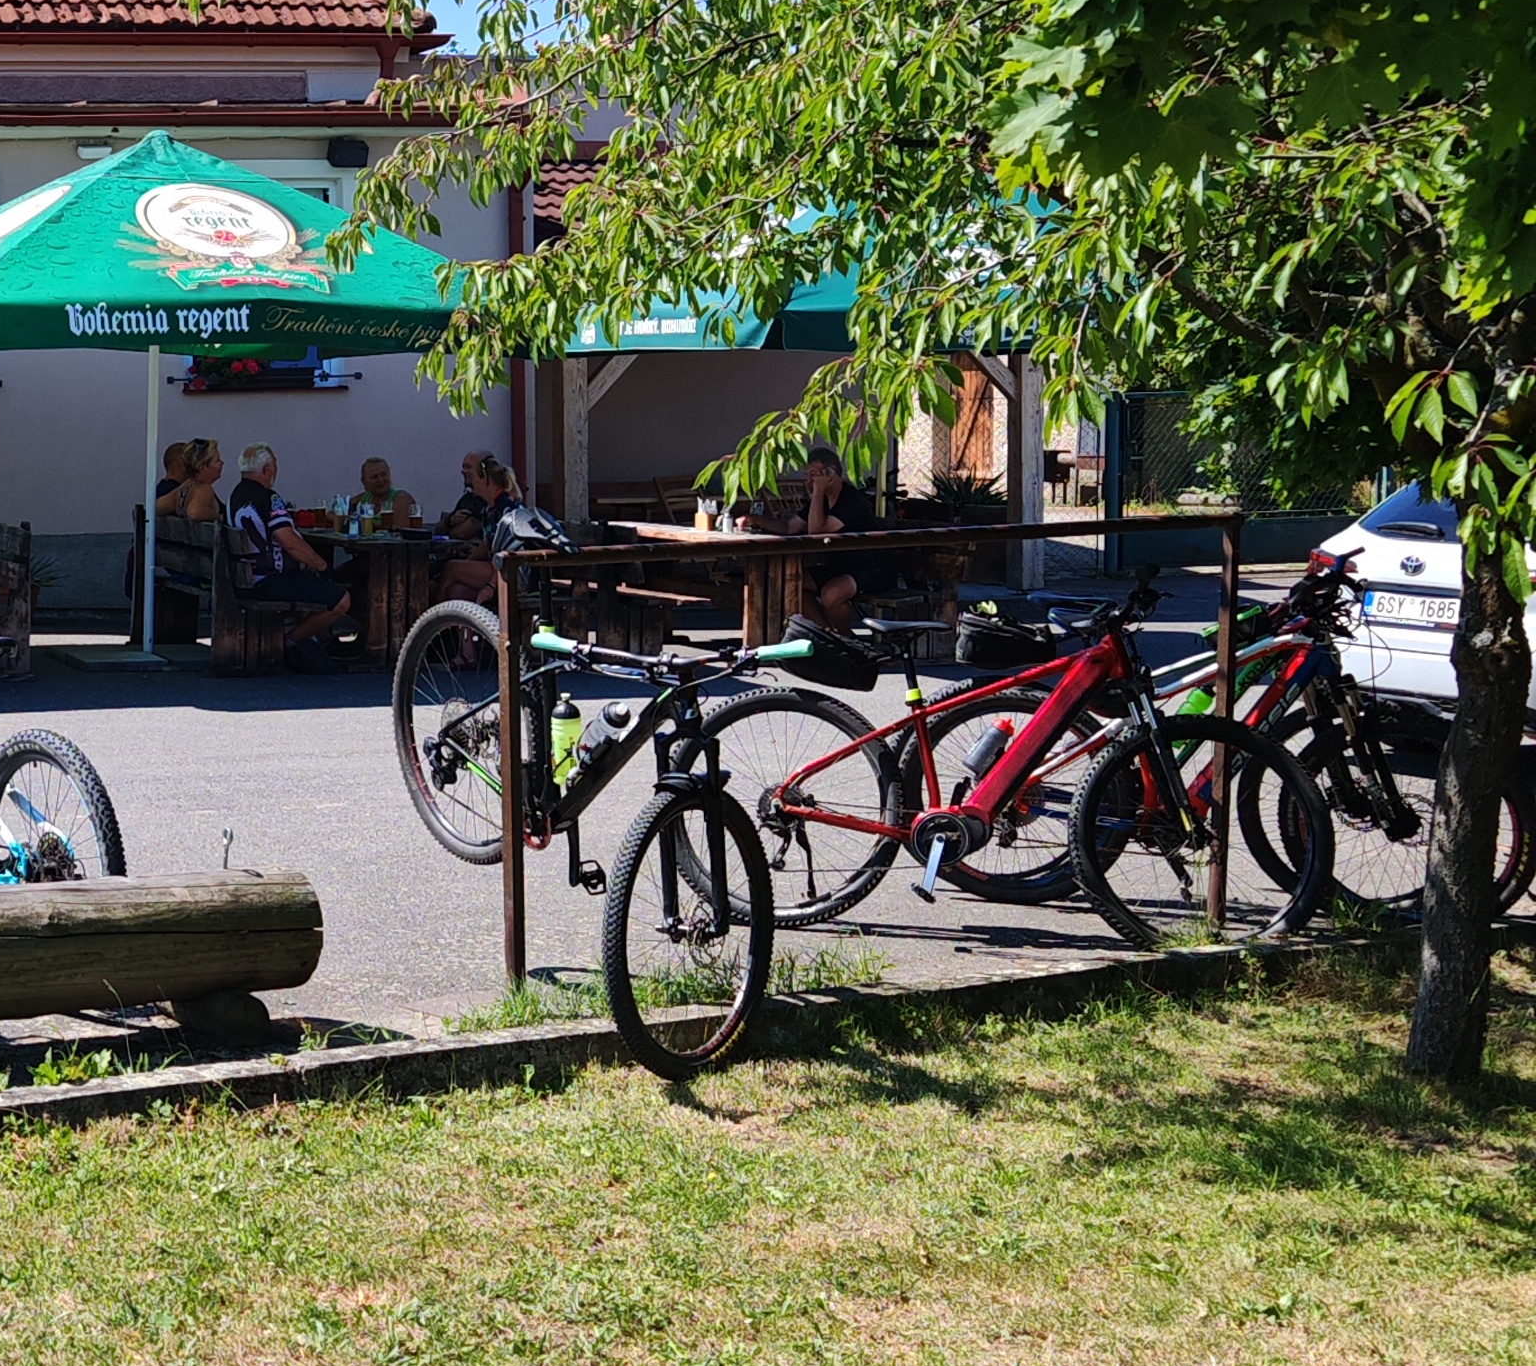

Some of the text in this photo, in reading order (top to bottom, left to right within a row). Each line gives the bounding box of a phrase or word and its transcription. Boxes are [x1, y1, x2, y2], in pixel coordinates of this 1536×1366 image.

[181, 216, 254, 230] regent
[65, 302, 251, 339] Bohemia regent
[261, 304, 446, 348] Tradiční české piv
[1376, 595, 1457, 620] 6SY 1685
